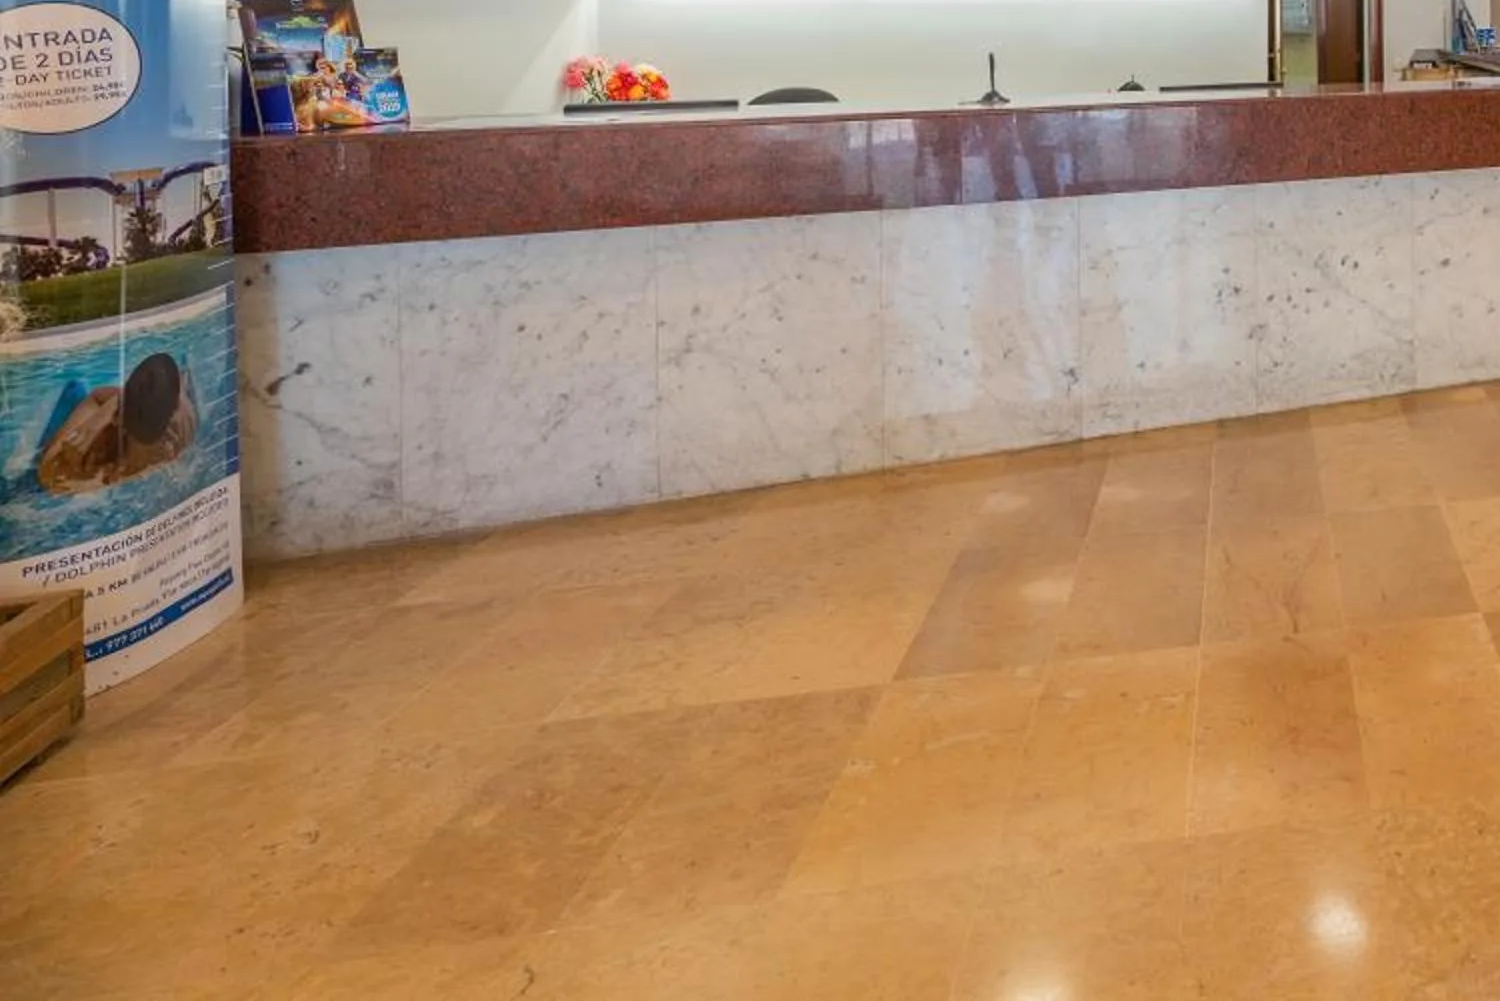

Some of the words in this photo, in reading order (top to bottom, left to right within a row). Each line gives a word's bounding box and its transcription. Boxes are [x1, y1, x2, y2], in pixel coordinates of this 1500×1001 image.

[4, 27, 113, 50] NTRADA
[35, 53, 49, 68] 2
[58, 45, 113, 66] DÍAS
[56, 66, 112, 81] TICKET
[54, 553, 126, 584] DOLPHIN
